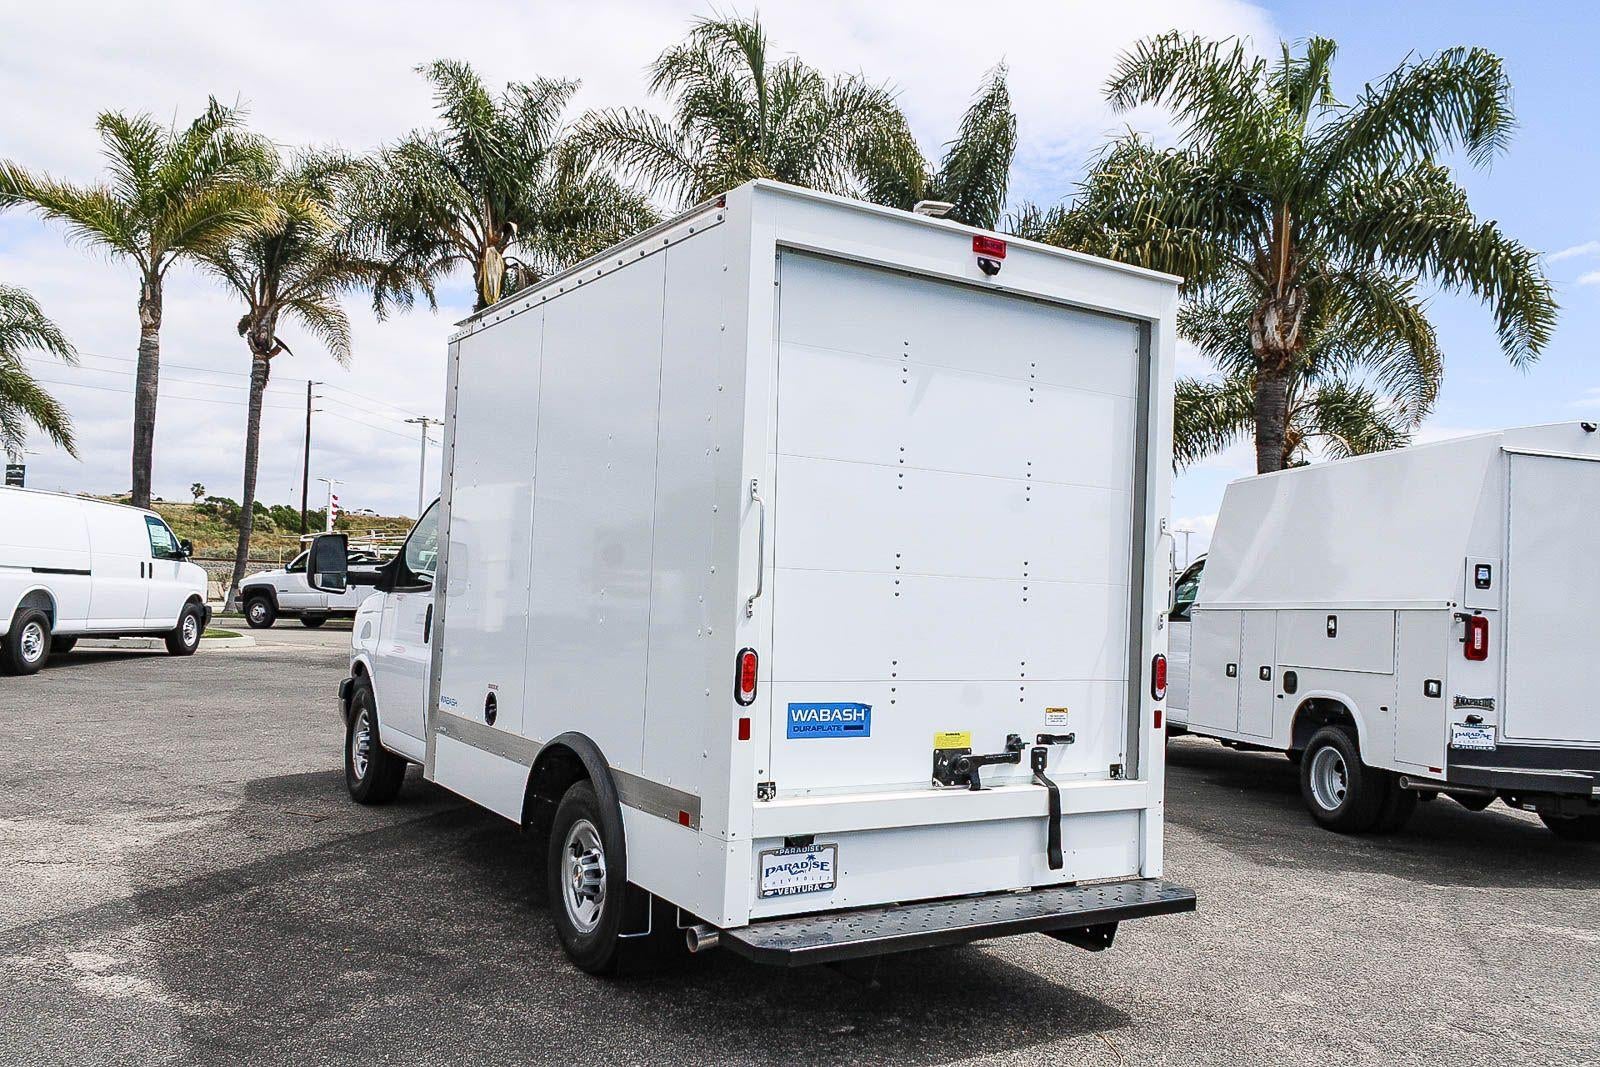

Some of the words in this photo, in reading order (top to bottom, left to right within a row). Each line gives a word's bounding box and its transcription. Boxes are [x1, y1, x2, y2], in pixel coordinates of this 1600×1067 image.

[791, 708, 865, 722] WABASH
[779, 845, 821, 855] PARADISE
[765, 859, 830, 878] PARADISE
[778, 884, 820, 895] VENTURA
